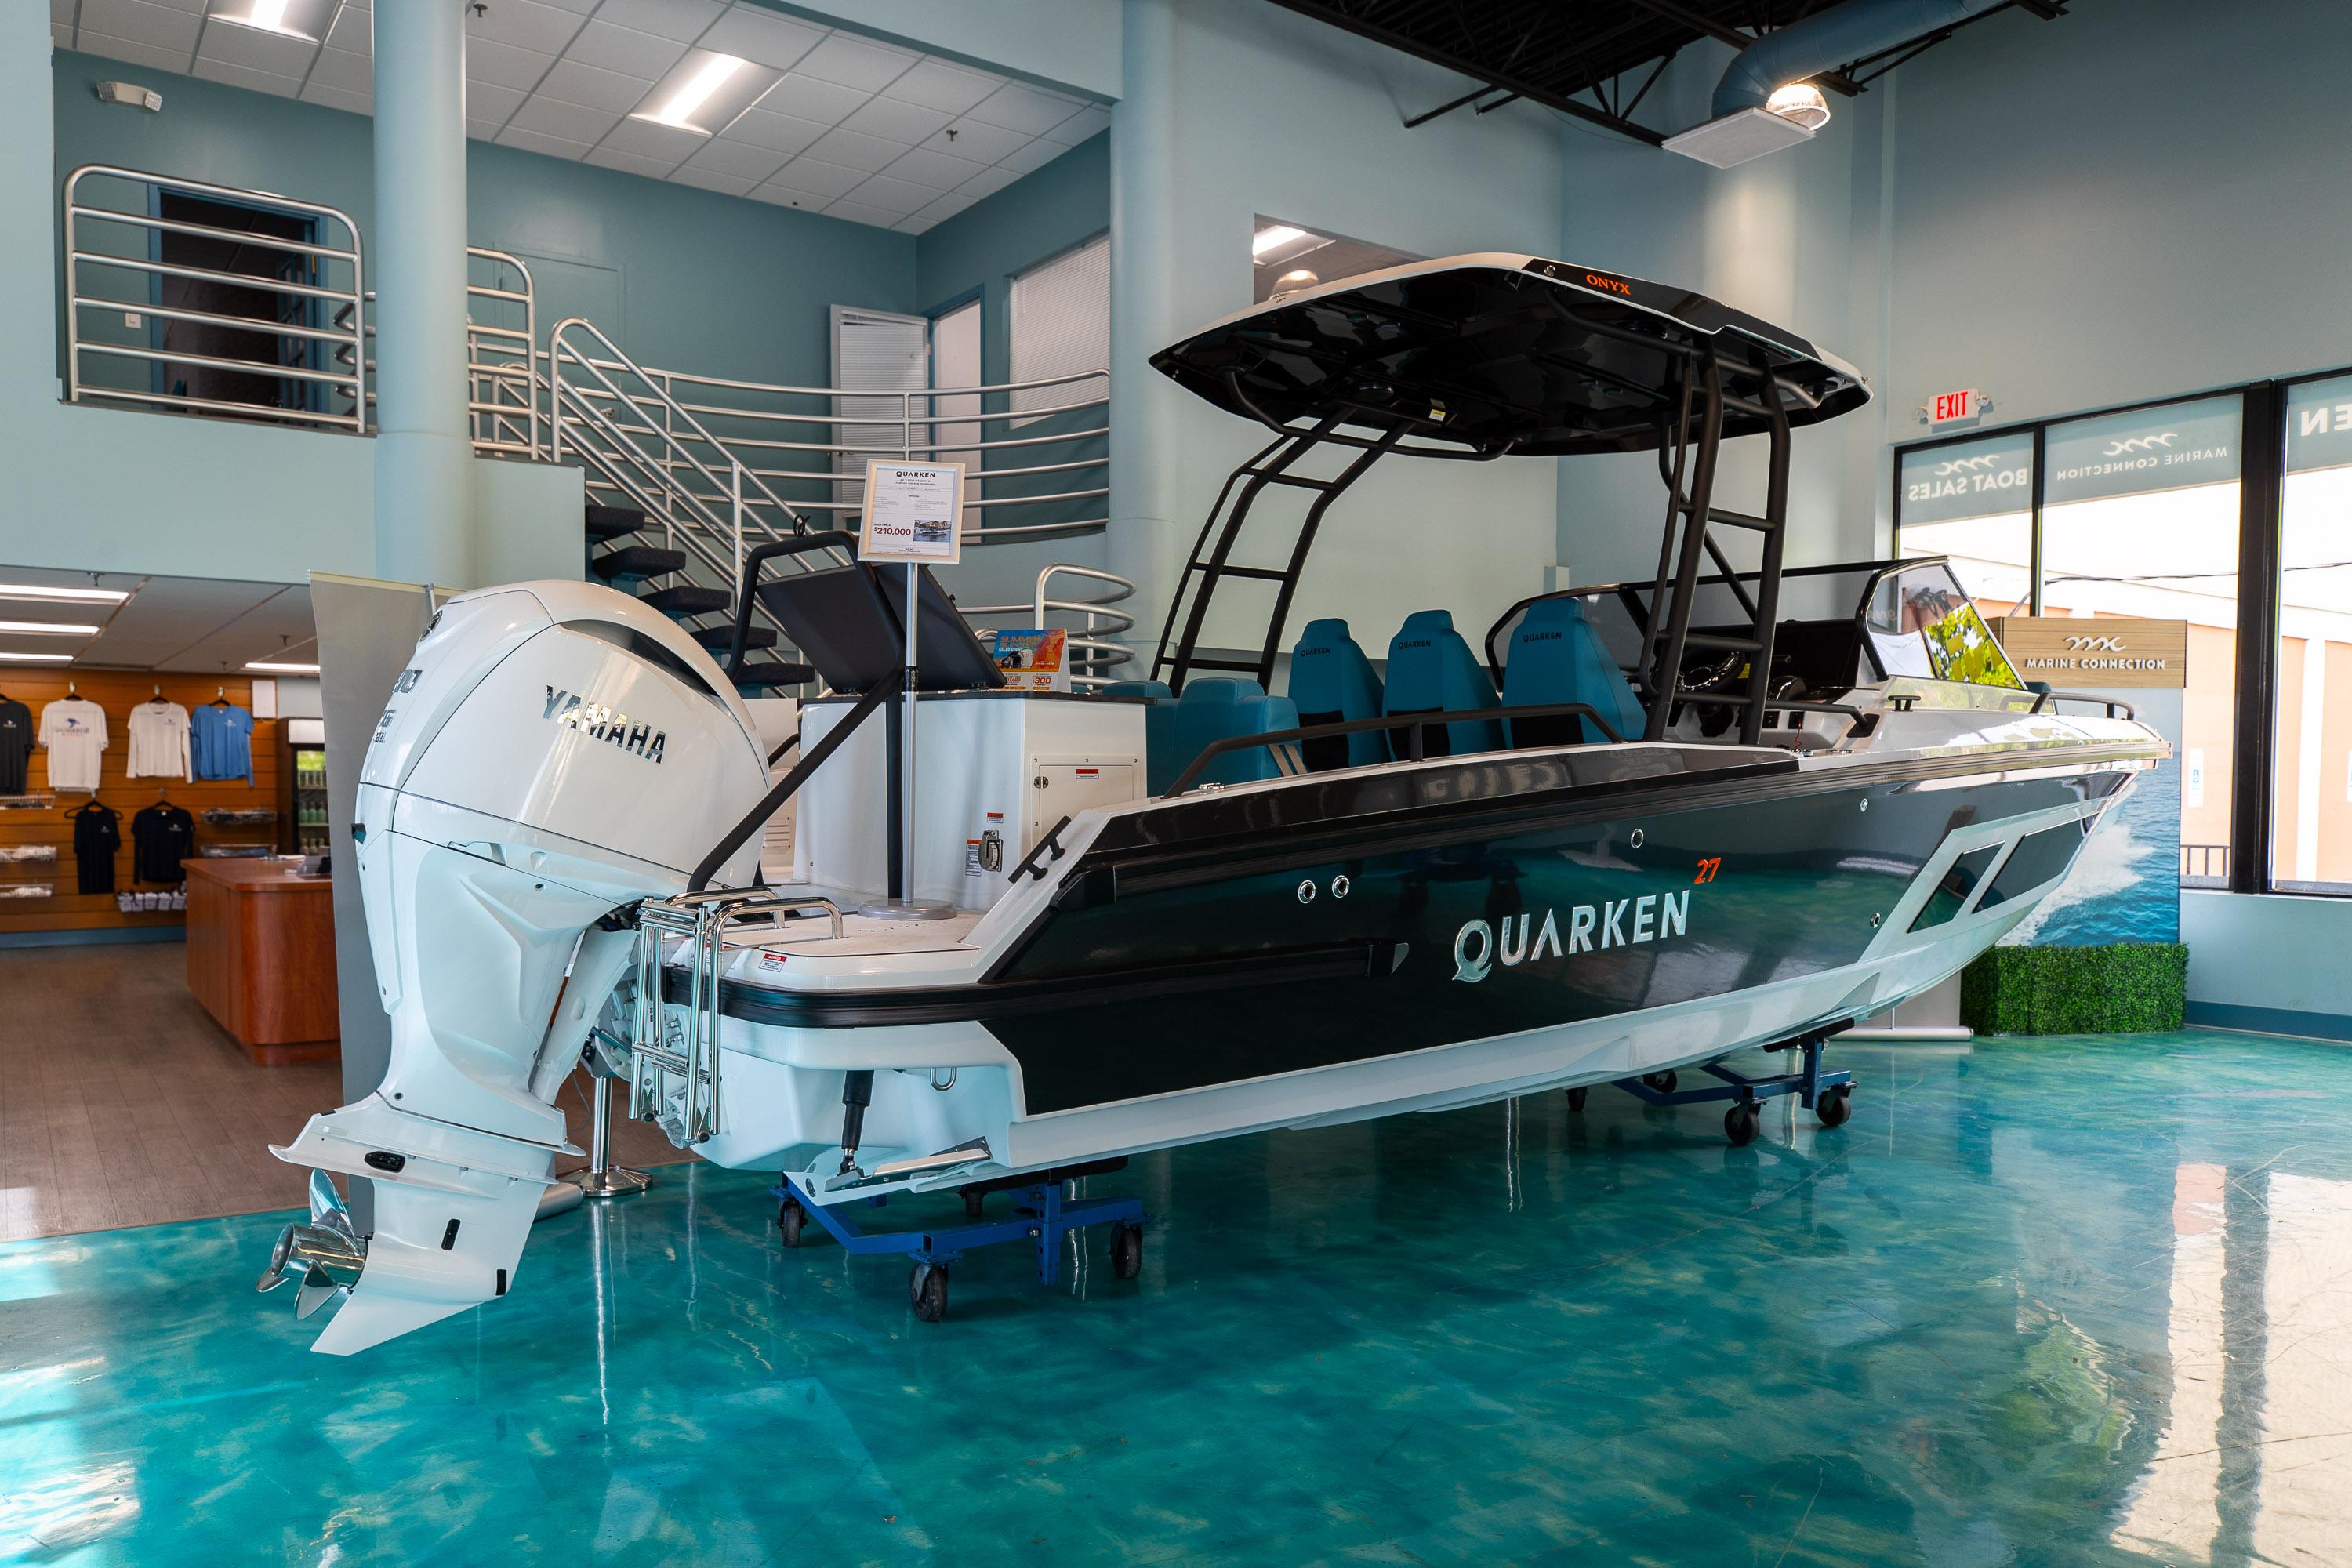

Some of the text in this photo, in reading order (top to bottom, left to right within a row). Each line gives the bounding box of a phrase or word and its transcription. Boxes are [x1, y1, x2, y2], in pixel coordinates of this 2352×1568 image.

[1585, 274, 1631, 296] ONYX
[1936, 390, 1969, 420] EXIT
[873, 527, 911, 535] $210,000
[1398, 640, 1431, 650] QUARKEN
[1523, 632, 1563, 643] QUARKEN
[1301, 647, 1330, 657] QUARKEN
[2026, 658, 2165, 670] MARINE CONNECTION
[543, 684, 666, 764] YAMAHA
[1693, 857, 1722, 885] 27
[1452, 889, 1690, 983] QUARKEN
